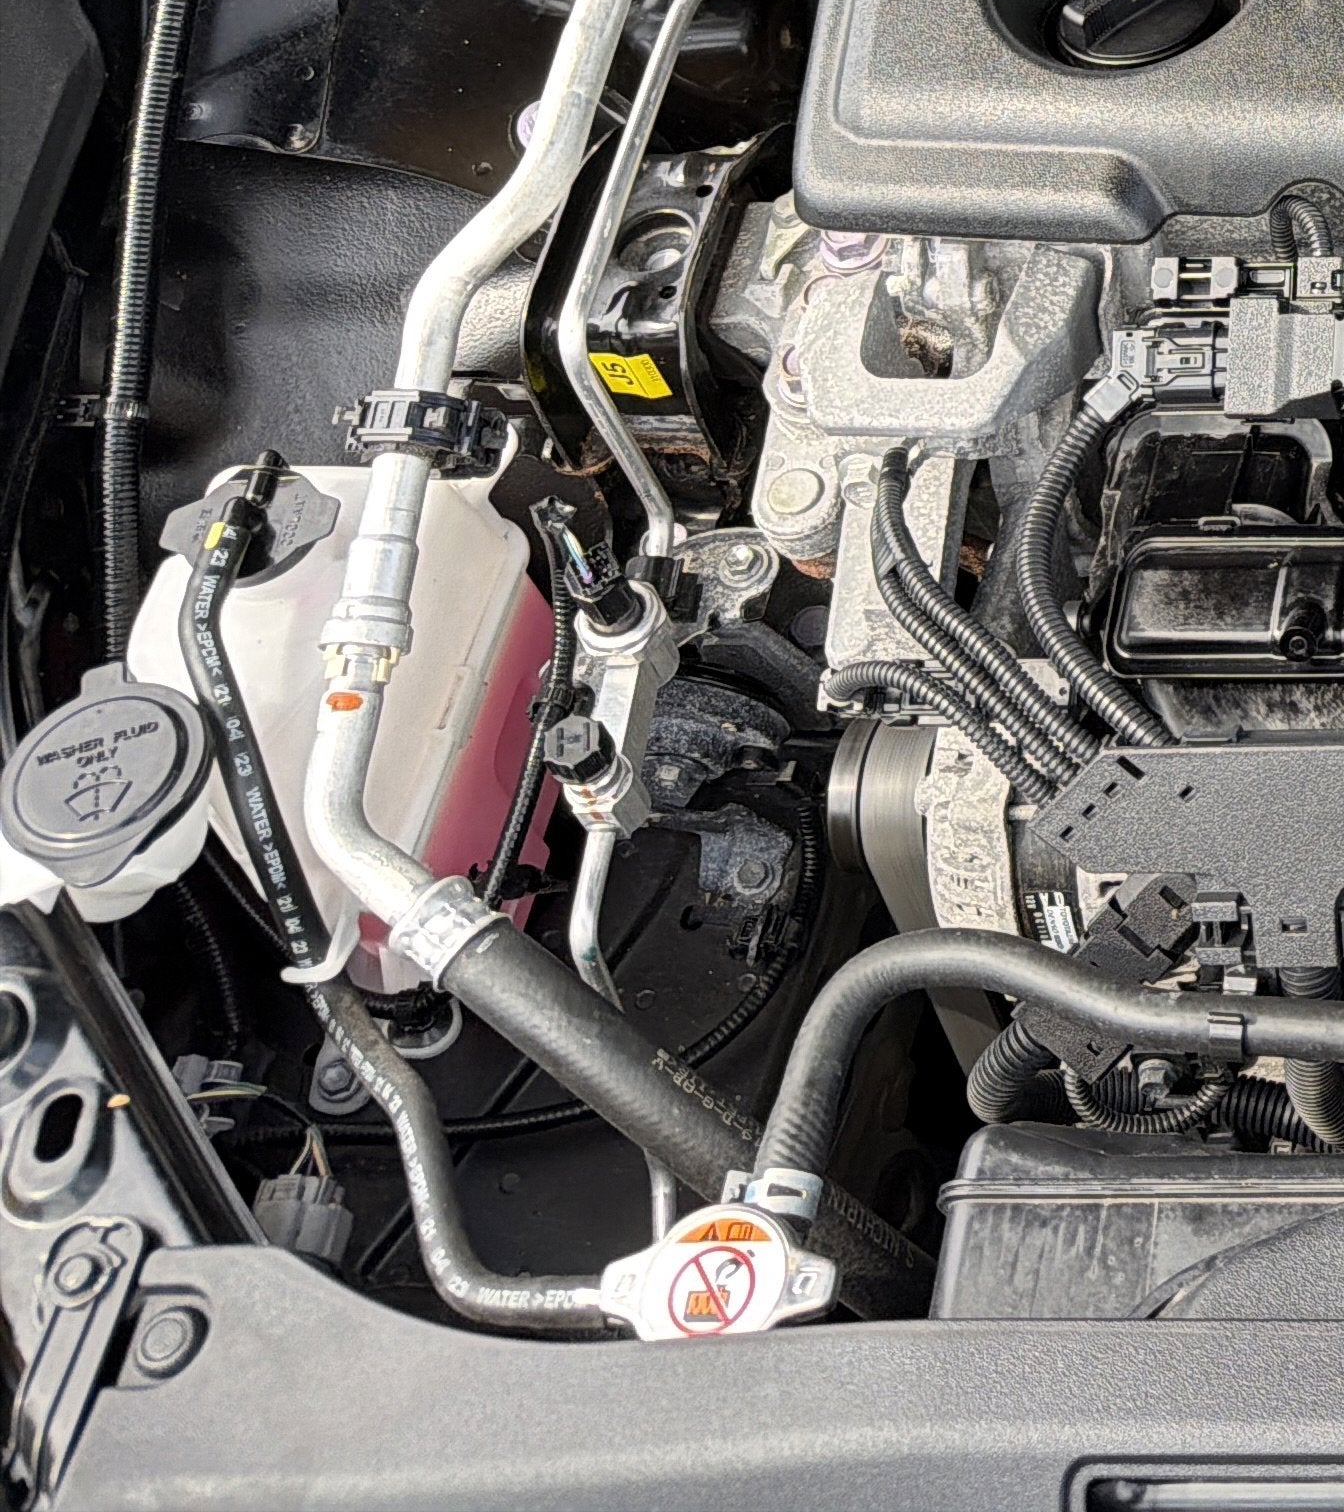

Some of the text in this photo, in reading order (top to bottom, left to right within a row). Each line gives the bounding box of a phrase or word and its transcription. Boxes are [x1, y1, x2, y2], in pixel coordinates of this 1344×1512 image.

[600, 362, 635, 386] J5
[194, 575, 220, 620] WATER
[245, 786, 274, 843] WATER
[37, 721, 160, 767] WASHER FLUID
[76, 746, 119, 769] ONLY
[395, 1110, 418, 1161] WATER
[476, 1286, 532, 1310] WATER
